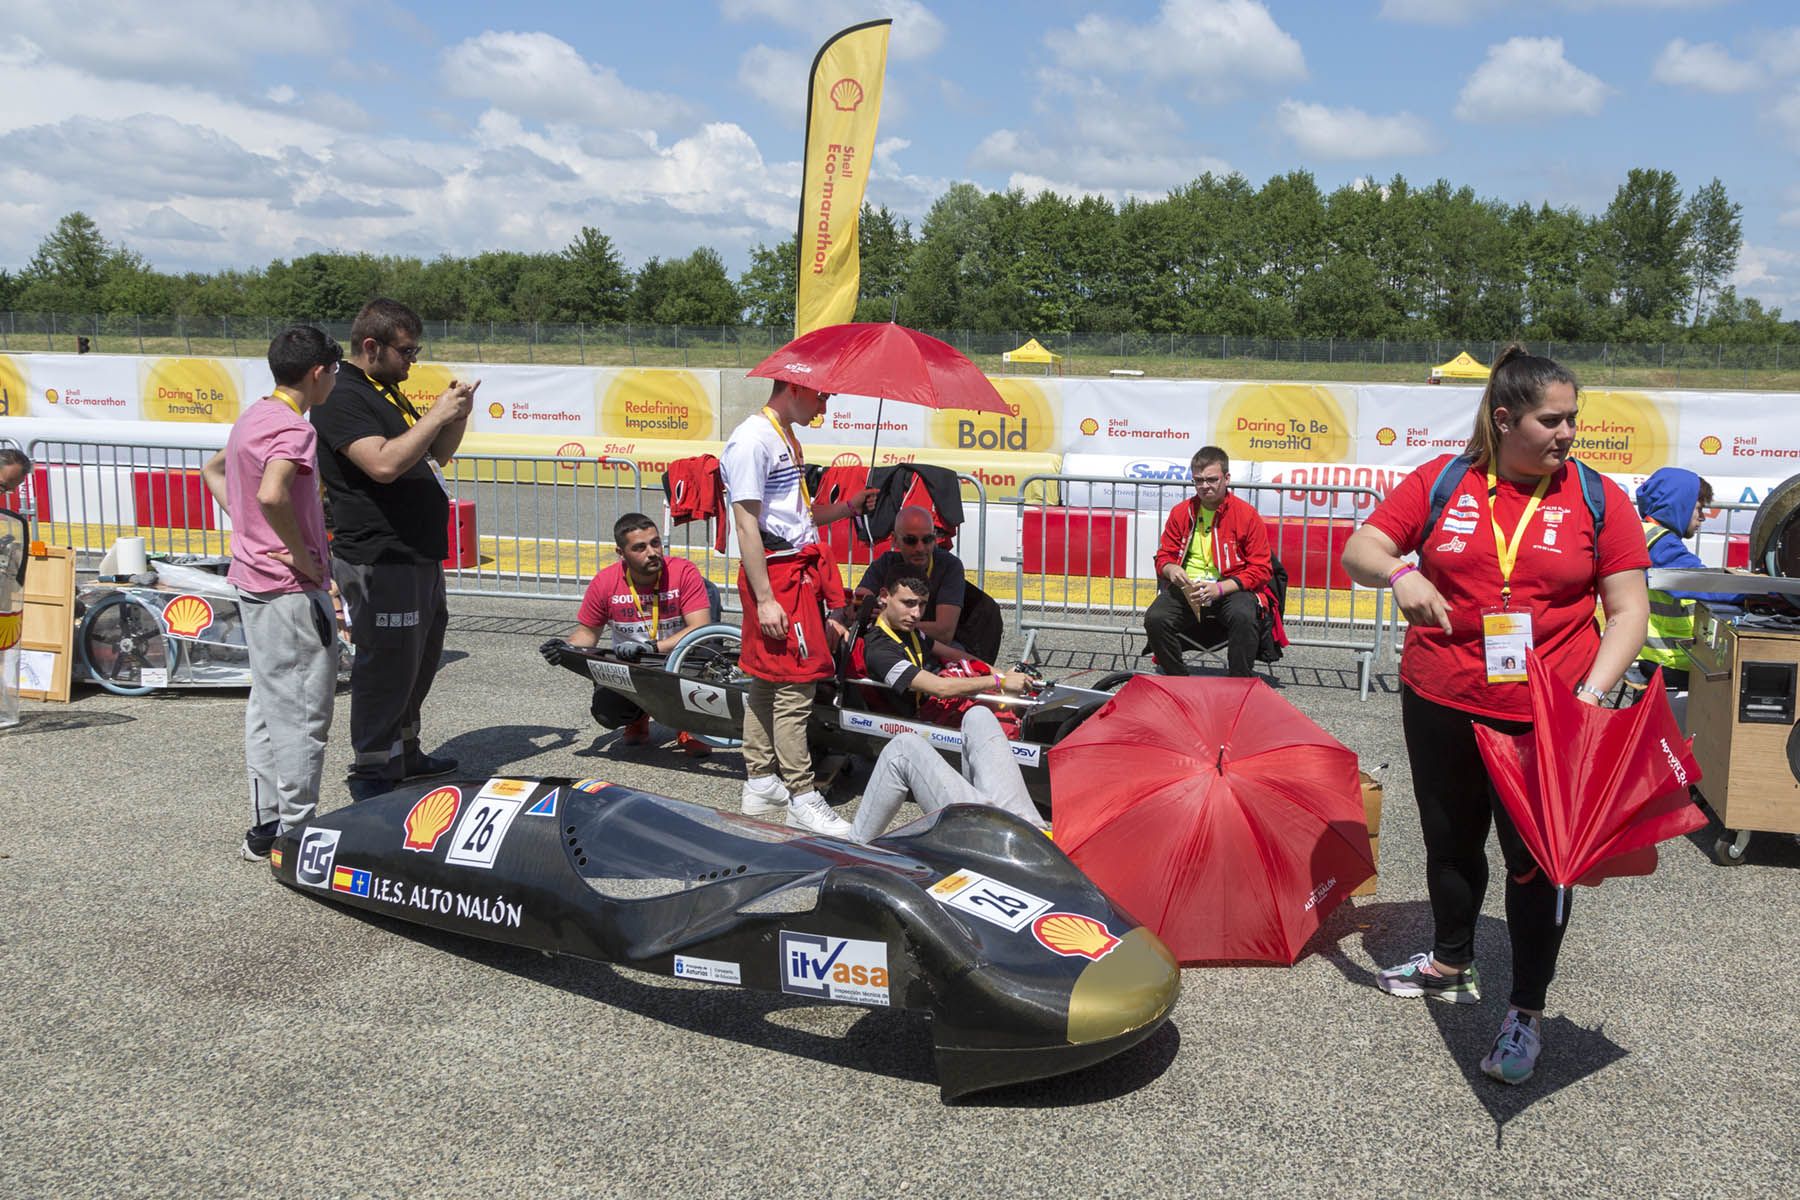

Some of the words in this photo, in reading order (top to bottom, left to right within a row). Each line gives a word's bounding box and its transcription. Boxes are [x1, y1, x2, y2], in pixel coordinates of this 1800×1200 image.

[842, 145, 855, 178] Shell
[813, 143, 842, 275] Eco-marathon
[65, 396, 126, 407] Eco-marathon
[158, 386, 193, 404] Daring
[195, 388, 208, 401] To
[210, 389, 224, 401] Be
[512, 402, 529, 411] Shell
[625, 400, 689, 419] Redefining
[512, 410, 581, 422] Eco-marathon
[832, 411, 852, 420] Shell
[625, 416, 689, 432] Impossible
[832, 420, 908, 432] Eco-marathon
[1108, 418, 1129, 427] Shell
[1236, 417, 1286, 436] Daring
[1289, 418, 1306, 433] To
[1309, 419, 1329, 434] Be
[958, 416, 1027, 450] Bold
[1107, 427, 1190, 440] Eco-marathon
[1406, 427, 1429, 437] Shell
[1405, 436, 1467, 448] Eco-mara
[1570, 435, 1629, 451] otential
[1733, 436, 1757, 446] Shell
[603, 443, 636, 455] Shell
[1012, 746, 1037, 758] DSV
[461, 806, 504, 853] 26
[373, 877, 406, 905] I.E.S.
[409, 885, 453, 914] ALTO
[456, 895, 523, 929] NALÓN
[969, 888, 1029, 919] 26
